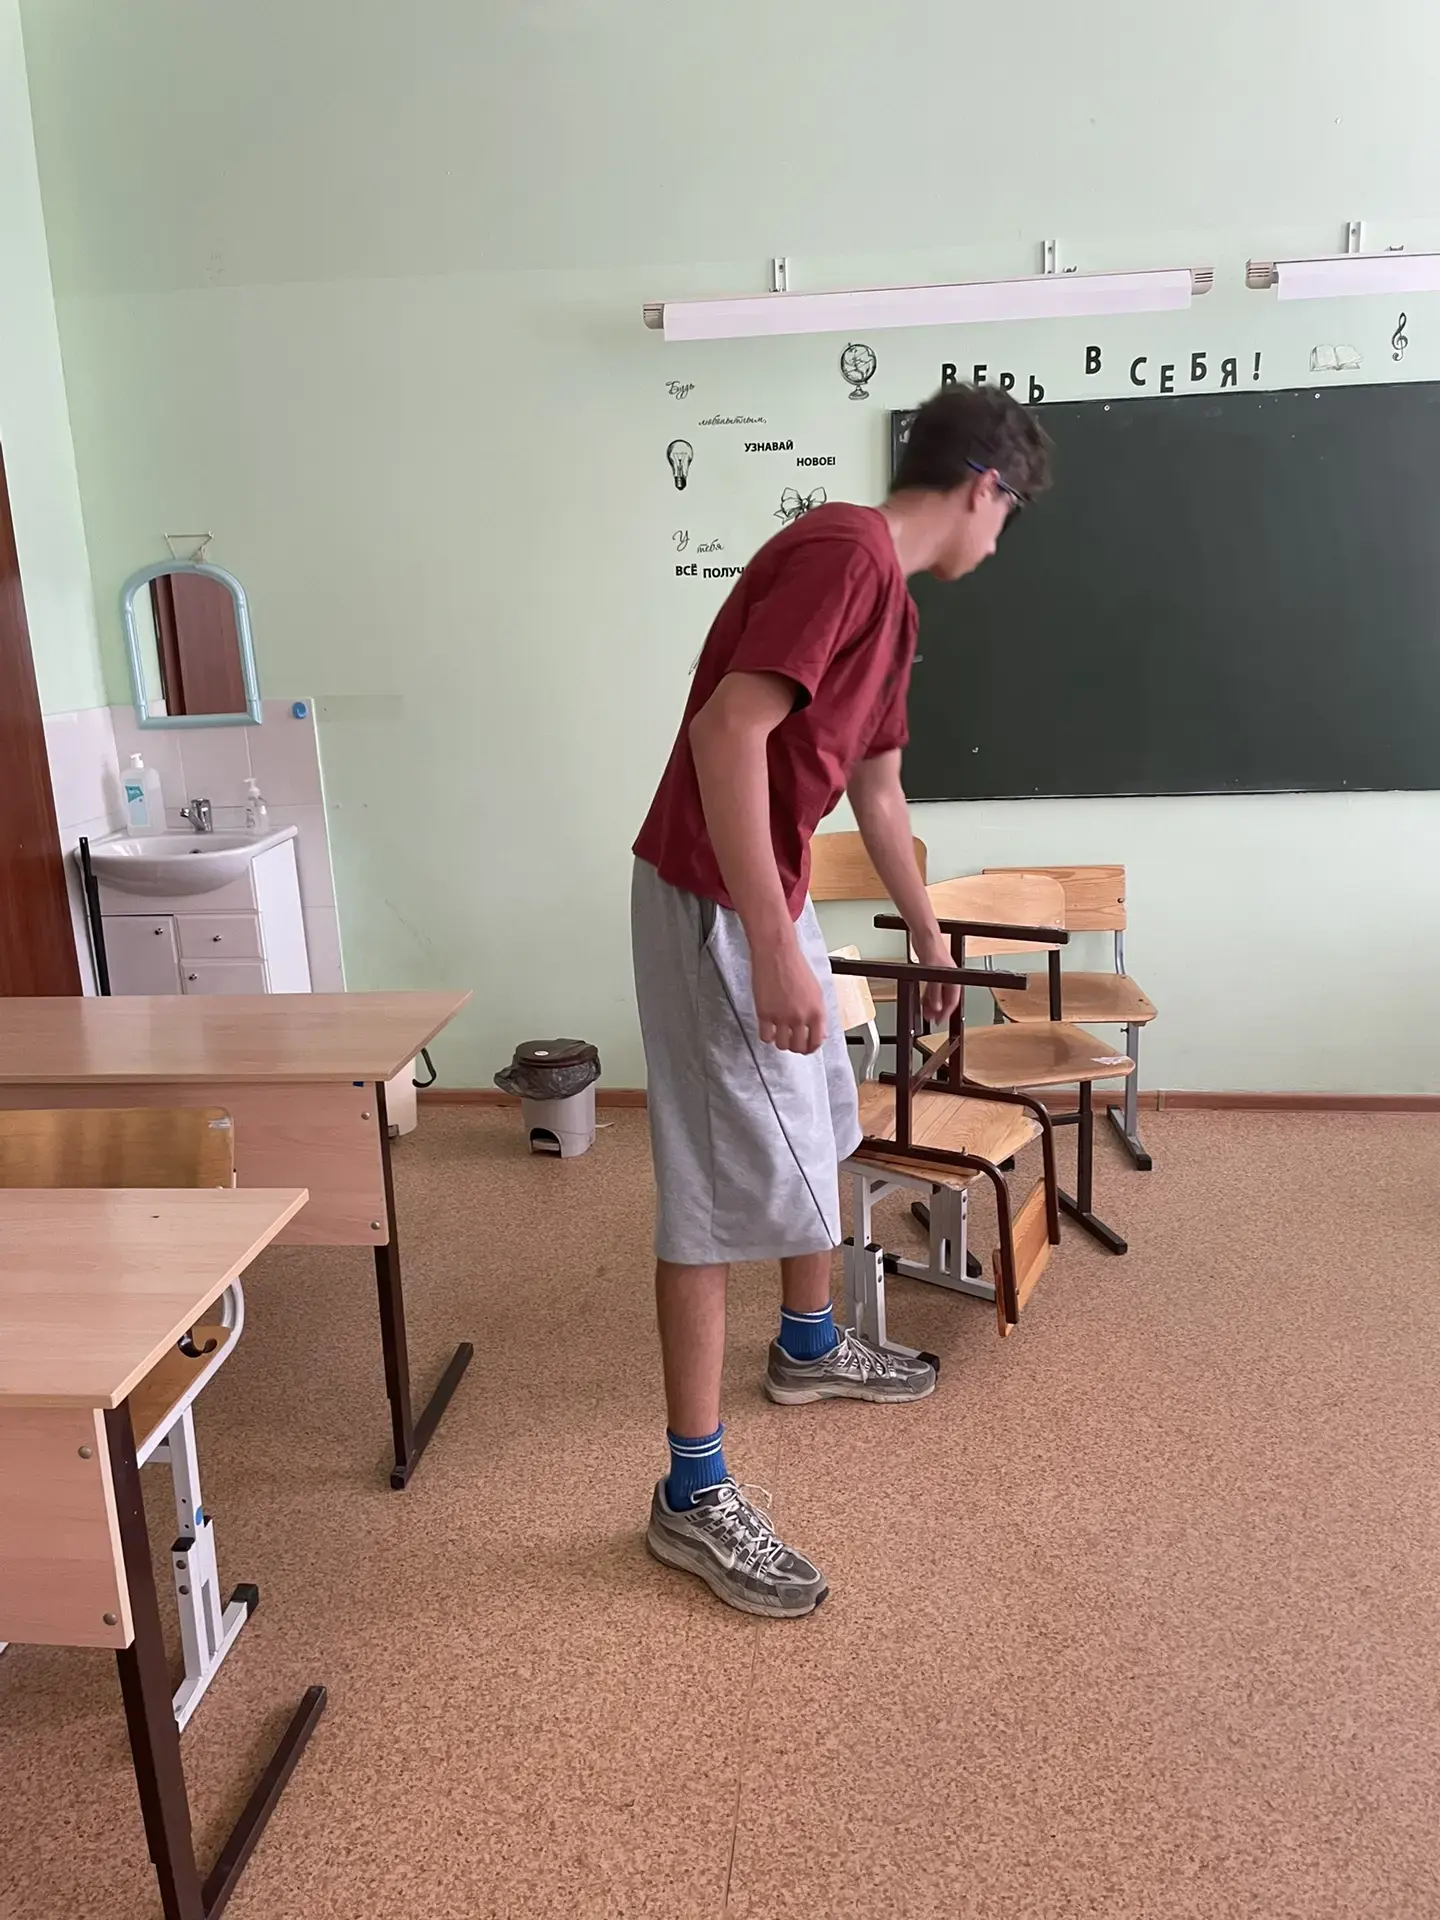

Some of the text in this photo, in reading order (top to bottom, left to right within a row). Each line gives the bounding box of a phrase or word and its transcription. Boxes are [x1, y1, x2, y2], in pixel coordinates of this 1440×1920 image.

[1085, 346, 1101, 375] В
[1130, 352, 1261, 393] СЕБЯ!
[665, 381, 695, 400] Будь
[744, 439, 794, 452] УЗНАВАЙ
[672, 530, 724, 554] У тебя
[675, 563, 698, 577] ВСЁ
